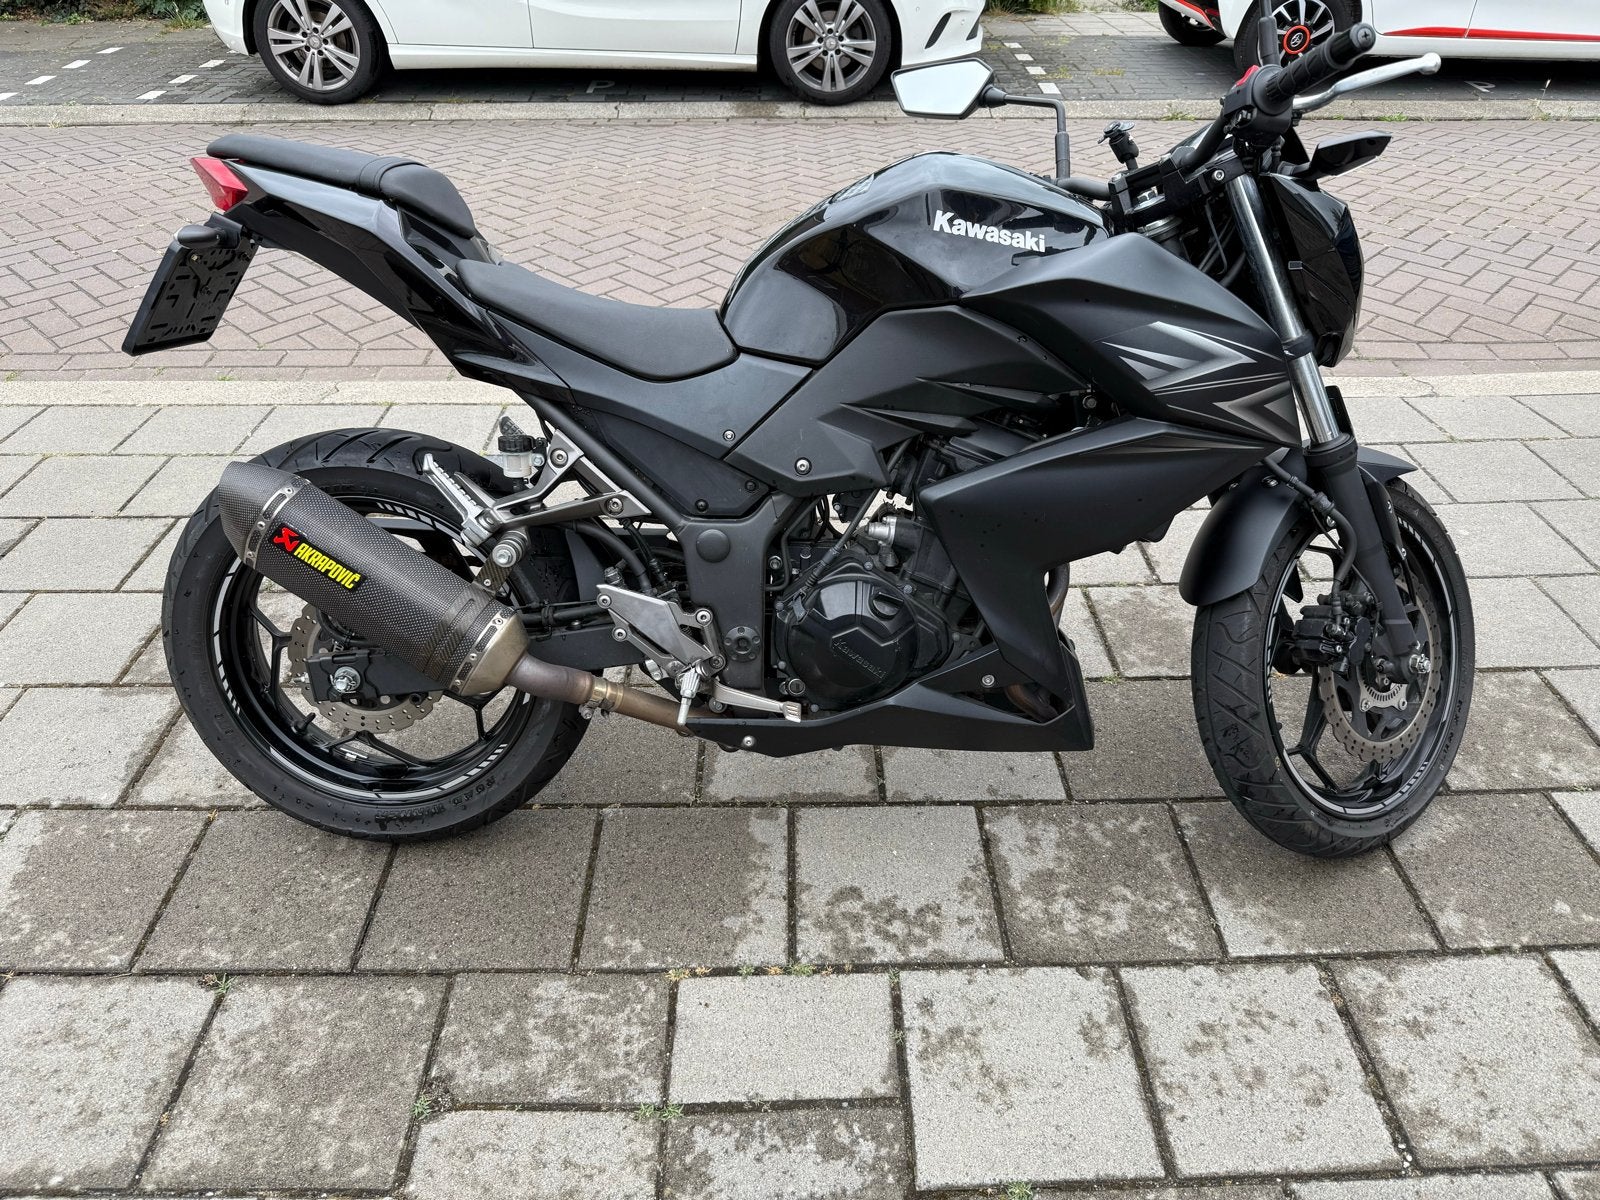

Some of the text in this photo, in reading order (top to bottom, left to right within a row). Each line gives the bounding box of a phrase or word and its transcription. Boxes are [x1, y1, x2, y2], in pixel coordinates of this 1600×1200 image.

[585, 80, 616, 93] P
[1464, 80, 1496, 92] P
[933, 210, 1046, 252] Kawasaki
[832, 638, 887, 680] Kawasaki
